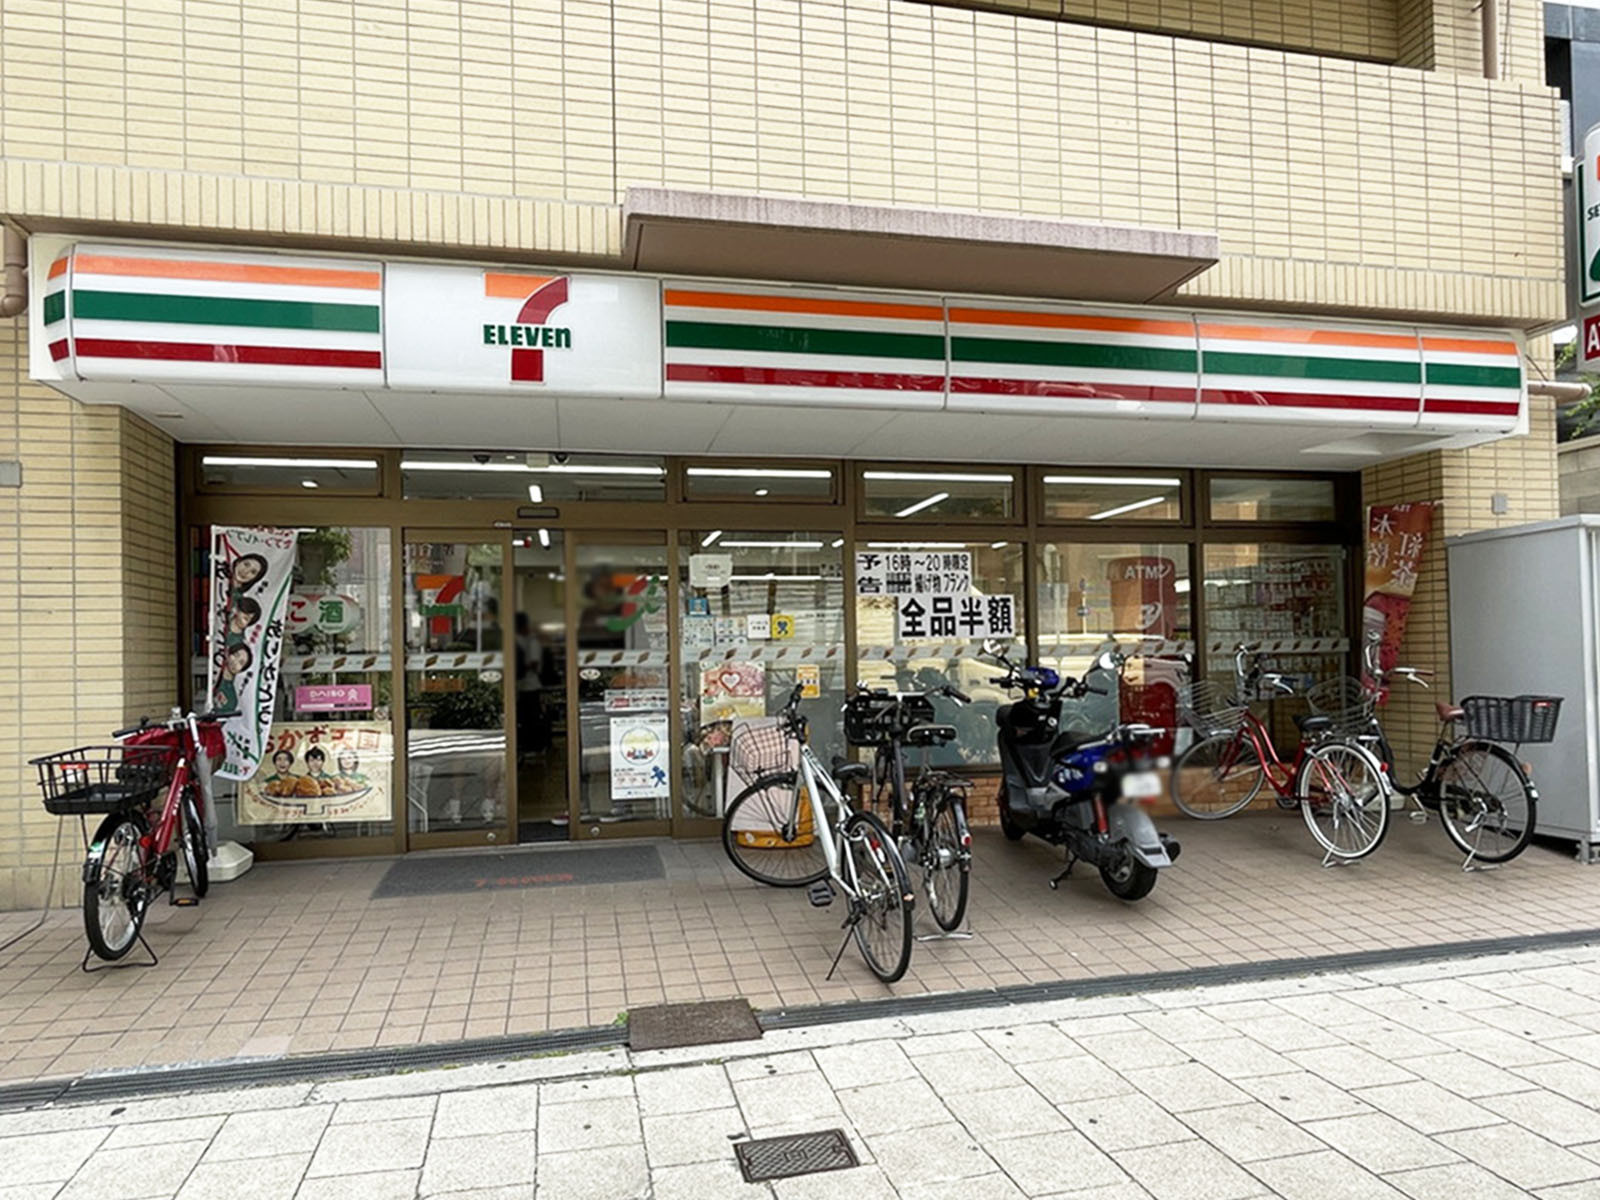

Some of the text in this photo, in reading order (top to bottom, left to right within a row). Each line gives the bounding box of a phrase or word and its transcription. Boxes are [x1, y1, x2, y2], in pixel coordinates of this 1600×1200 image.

[857, 554, 883, 593] 予告
[1124, 565, 1158, 580] ATM
[318, 600, 345, 623] 酒
[901, 596, 1012, 637] 全品半額
